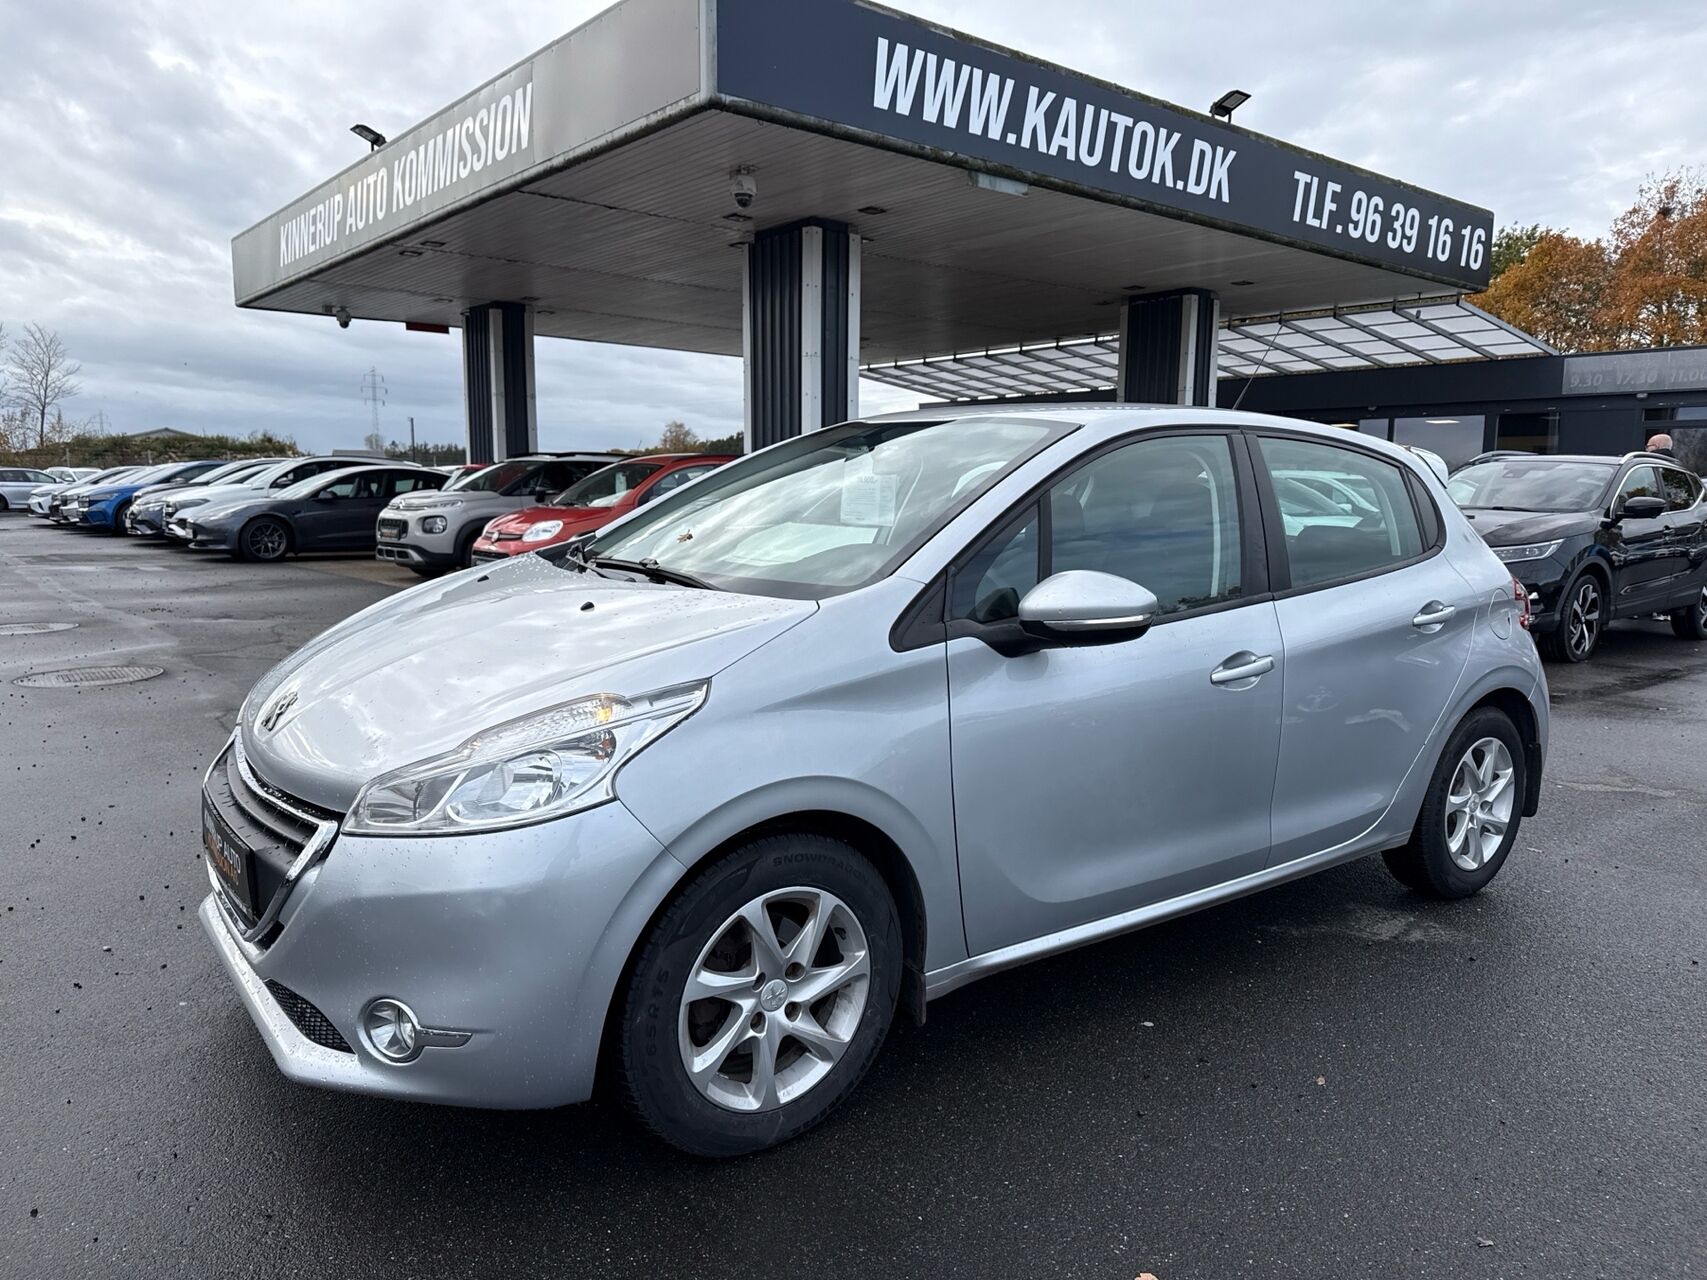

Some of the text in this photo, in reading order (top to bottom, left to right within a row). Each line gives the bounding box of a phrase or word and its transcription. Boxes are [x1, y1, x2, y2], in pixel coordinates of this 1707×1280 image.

[280, 82, 532, 267] KINNERUP AUTO KOMMISSION
[873, 36, 1237, 203] WWW.KAUTOK.DK
[1293, 171, 1486, 270] TLF. 96 39 16 16
